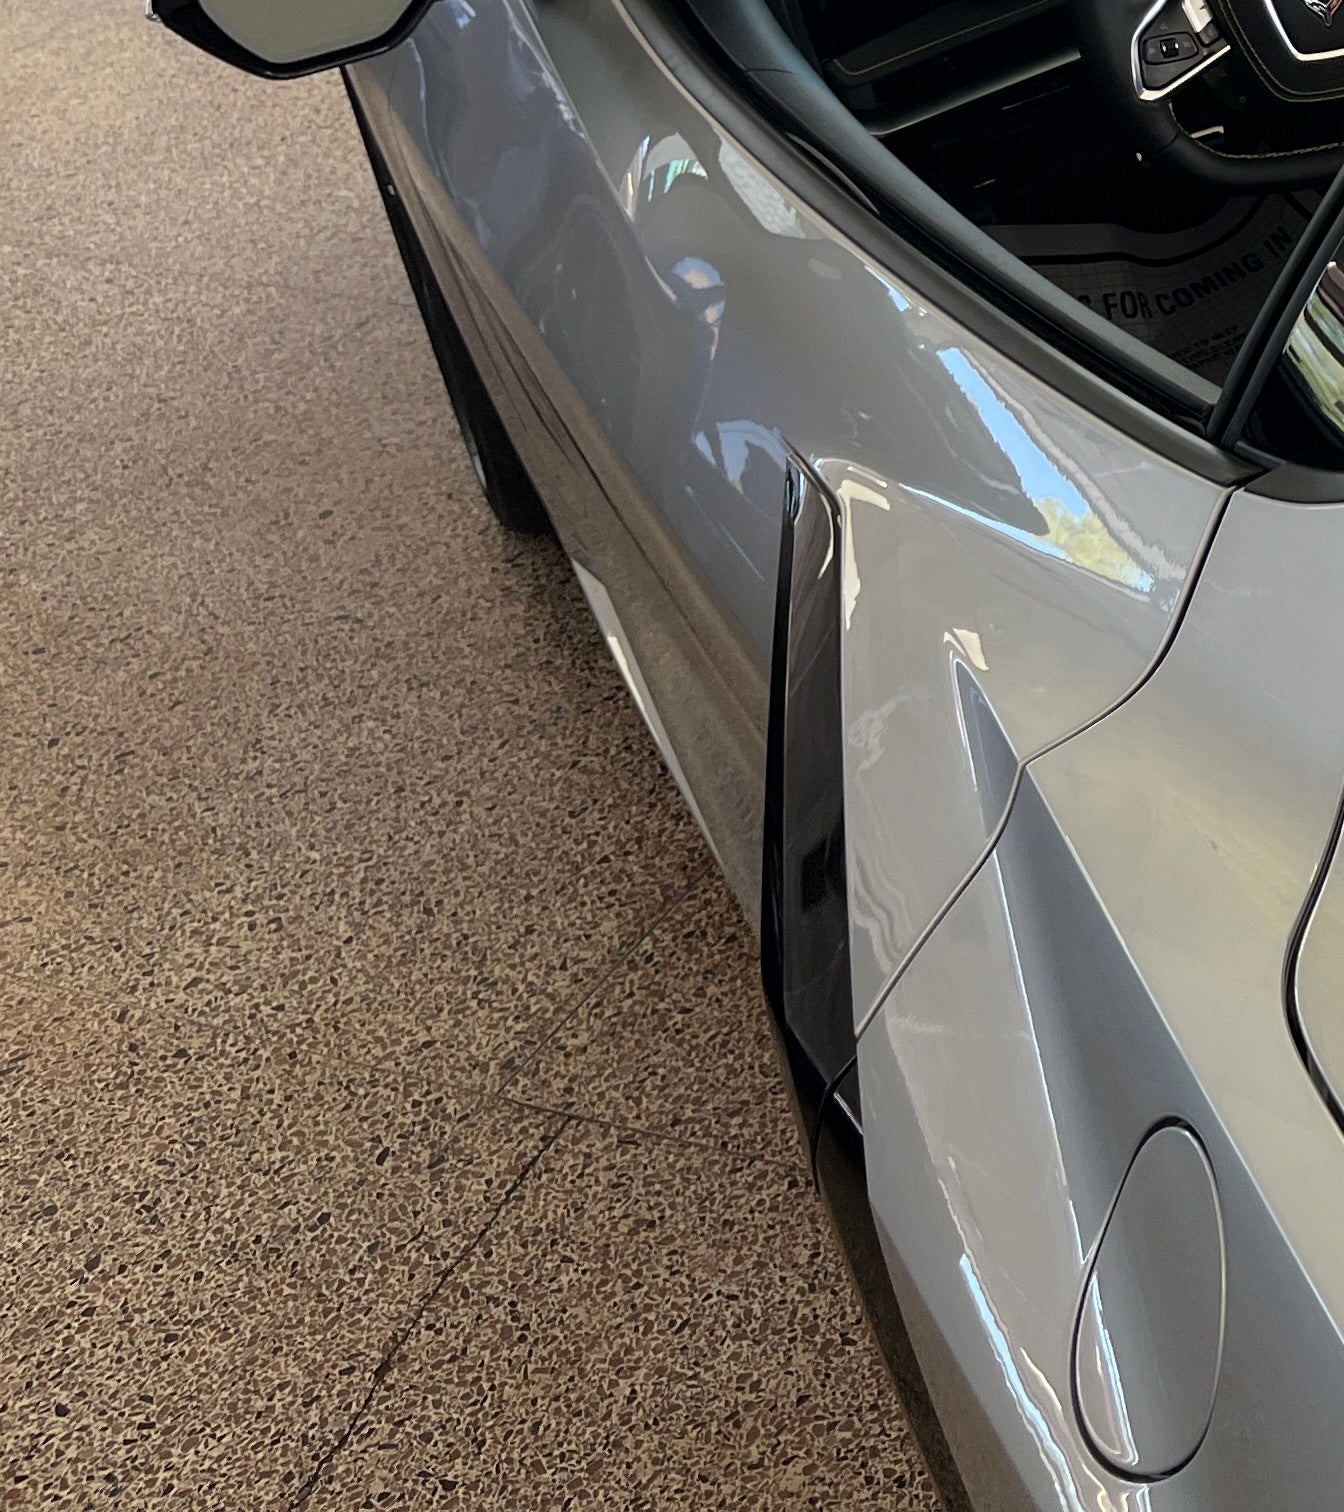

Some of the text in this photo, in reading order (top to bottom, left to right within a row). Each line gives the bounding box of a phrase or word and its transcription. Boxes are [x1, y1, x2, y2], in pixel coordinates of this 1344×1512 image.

[1102, 225, 1293, 321] FOR COMING IN
